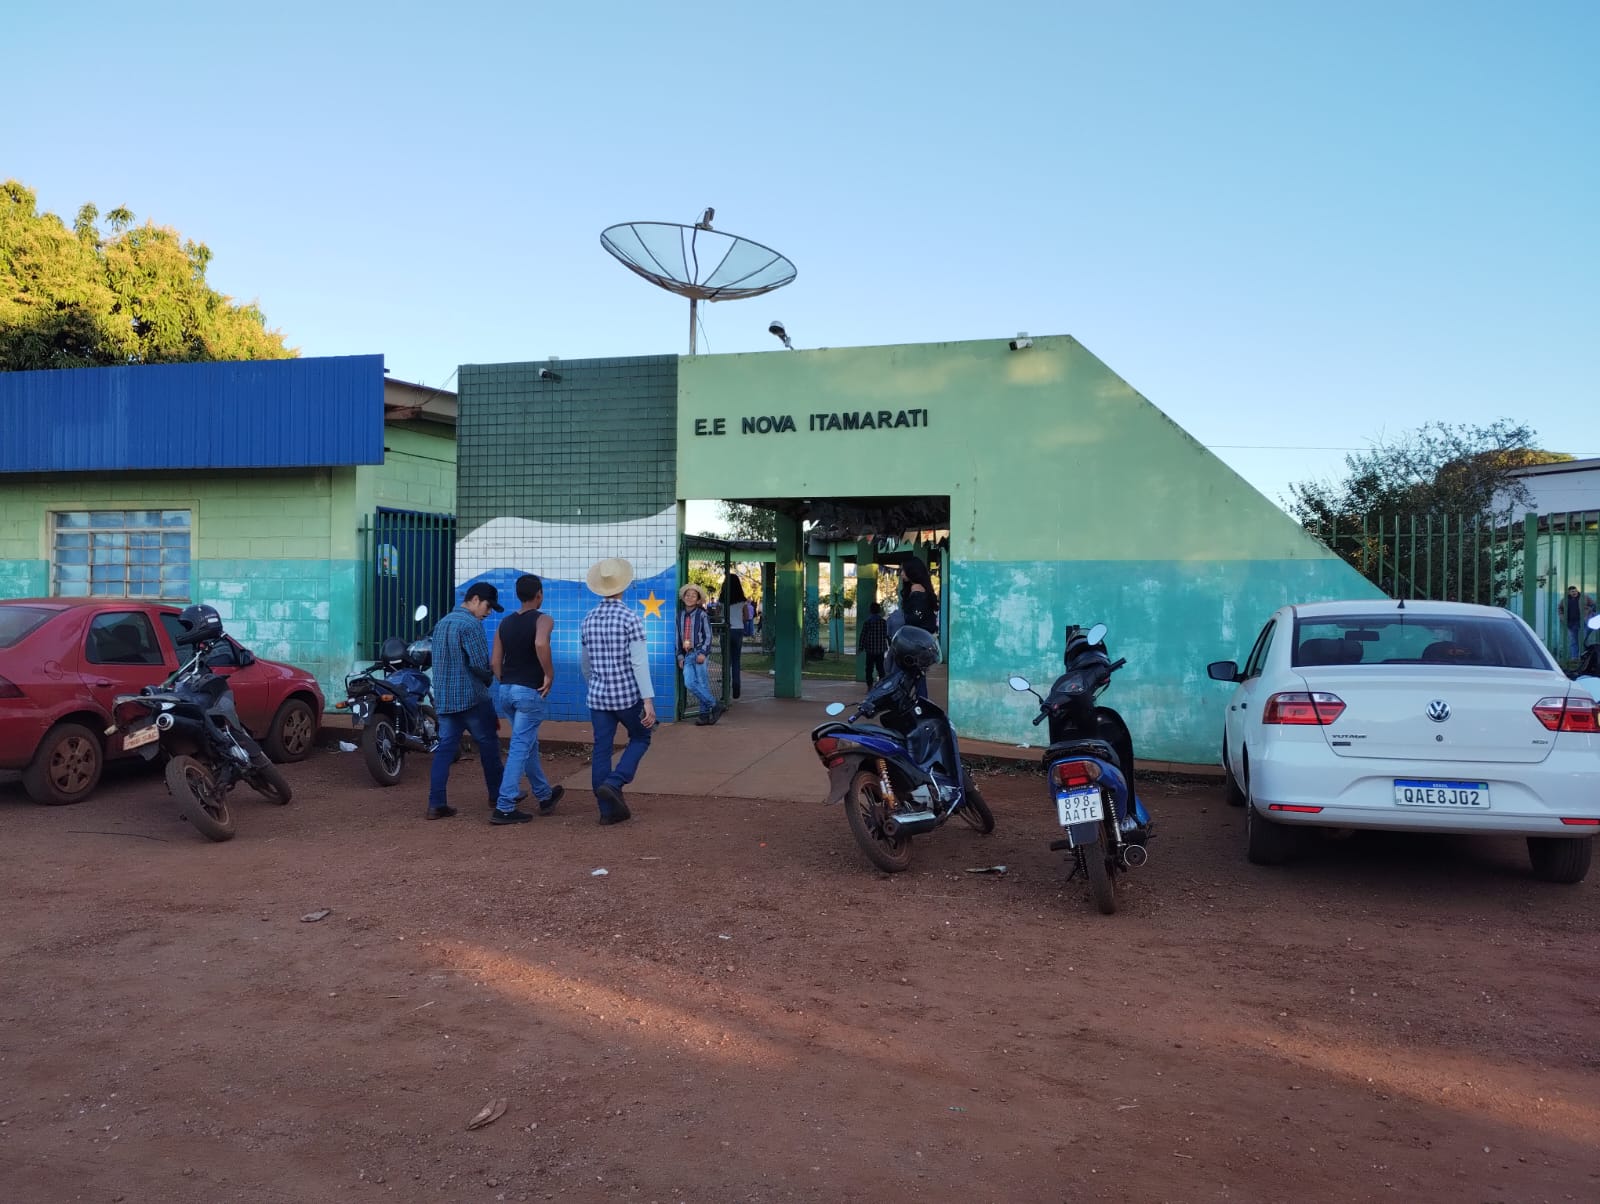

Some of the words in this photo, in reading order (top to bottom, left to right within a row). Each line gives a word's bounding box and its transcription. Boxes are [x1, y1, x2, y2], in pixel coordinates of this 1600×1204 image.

[695, 418, 726, 436] E.E
[741, 415, 797, 435] NOVA
[809, 409, 928, 431] ITAMARATI
[1065, 796, 1090, 809] 898
[1404, 788, 1480, 805] QAE8J02
[1065, 807, 1097, 821] AATE
